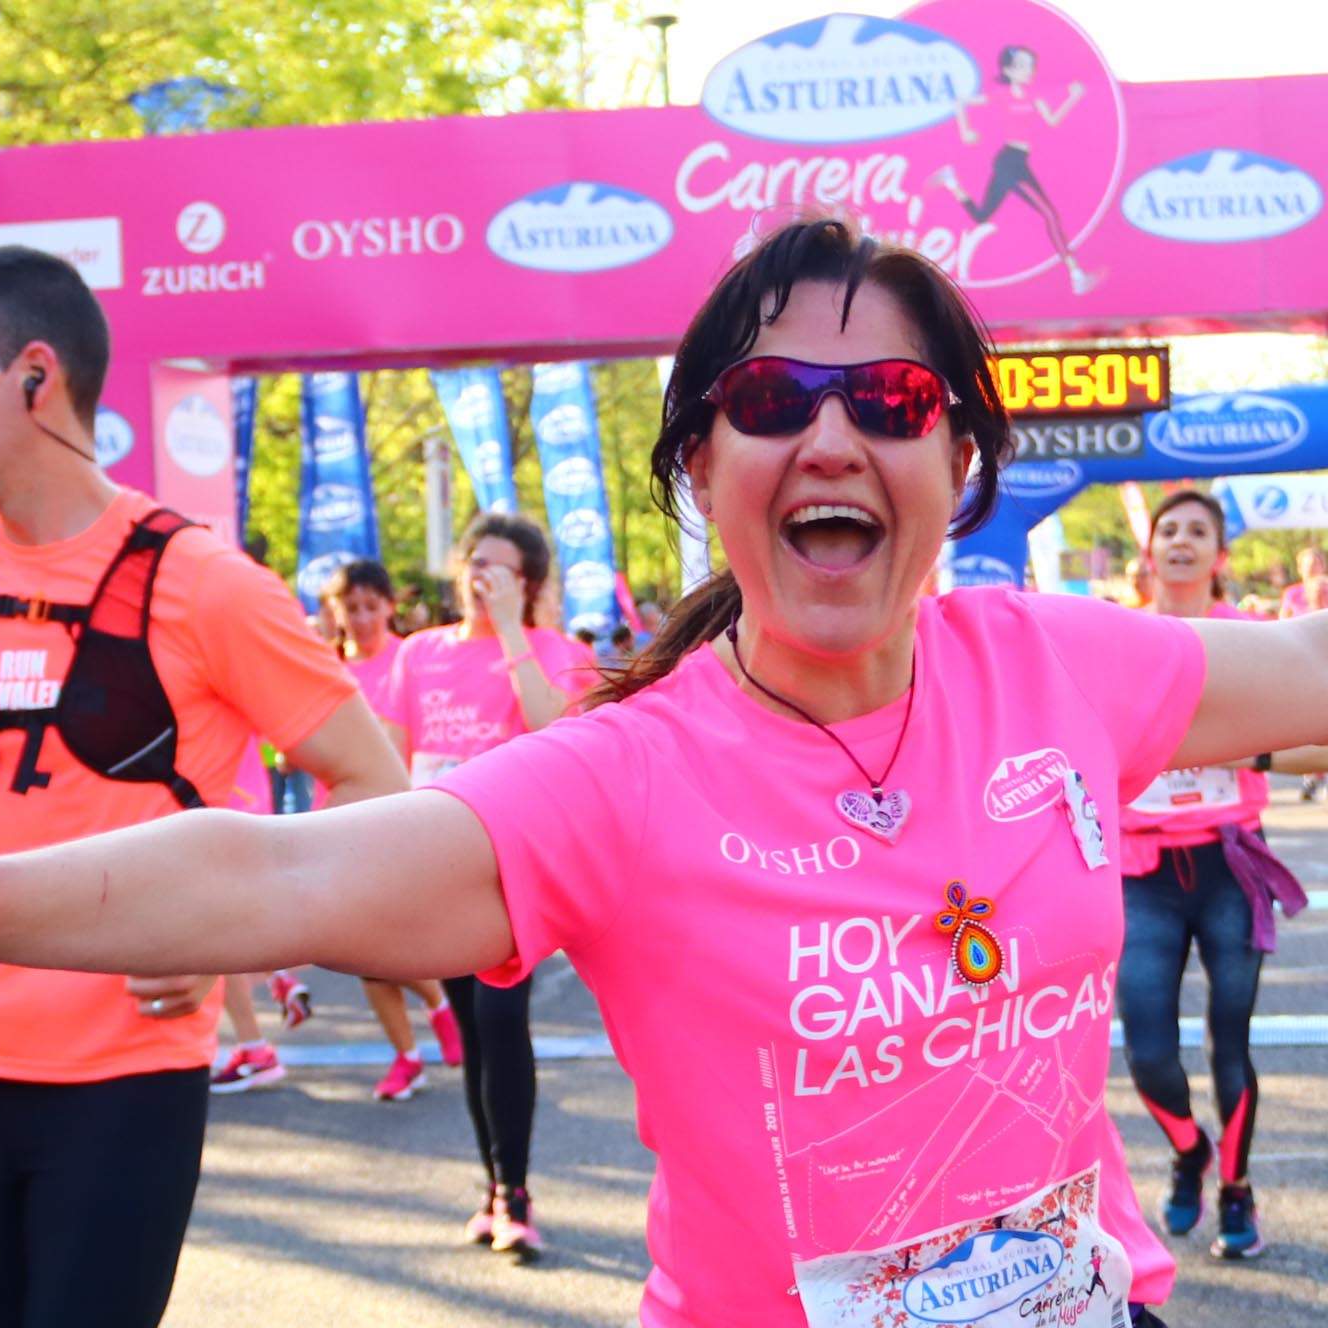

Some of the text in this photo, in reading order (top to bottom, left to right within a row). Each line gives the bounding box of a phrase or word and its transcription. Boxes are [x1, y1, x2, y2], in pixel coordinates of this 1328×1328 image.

[724, 67, 959, 114] ASTURIANA
[1135, 187, 1308, 222] ASTURIANA
[291, 213, 464, 261] OYSHO
[500, 218, 657, 252] ASTURIANA
[140, 261, 265, 297] ZURICH
[1168, 415, 1296, 449] ASTURIANA
[0, 649, 49, 679] RUN
[719, 831, 861, 877] OYSHO
[787, 914, 922, 983] HOY
[792, 962, 1118, 1097] LAS CHICAS
[770, 1136, 784, 1167] MUJER
[777, 1167, 788, 1181] LA
[779, 1181, 789, 1195] DE
[782, 1195, 798, 1239] CARRERA
[918, 1252, 1056, 1314] ASTURIANA
[1019, 1286, 1077, 1318] Carrera
